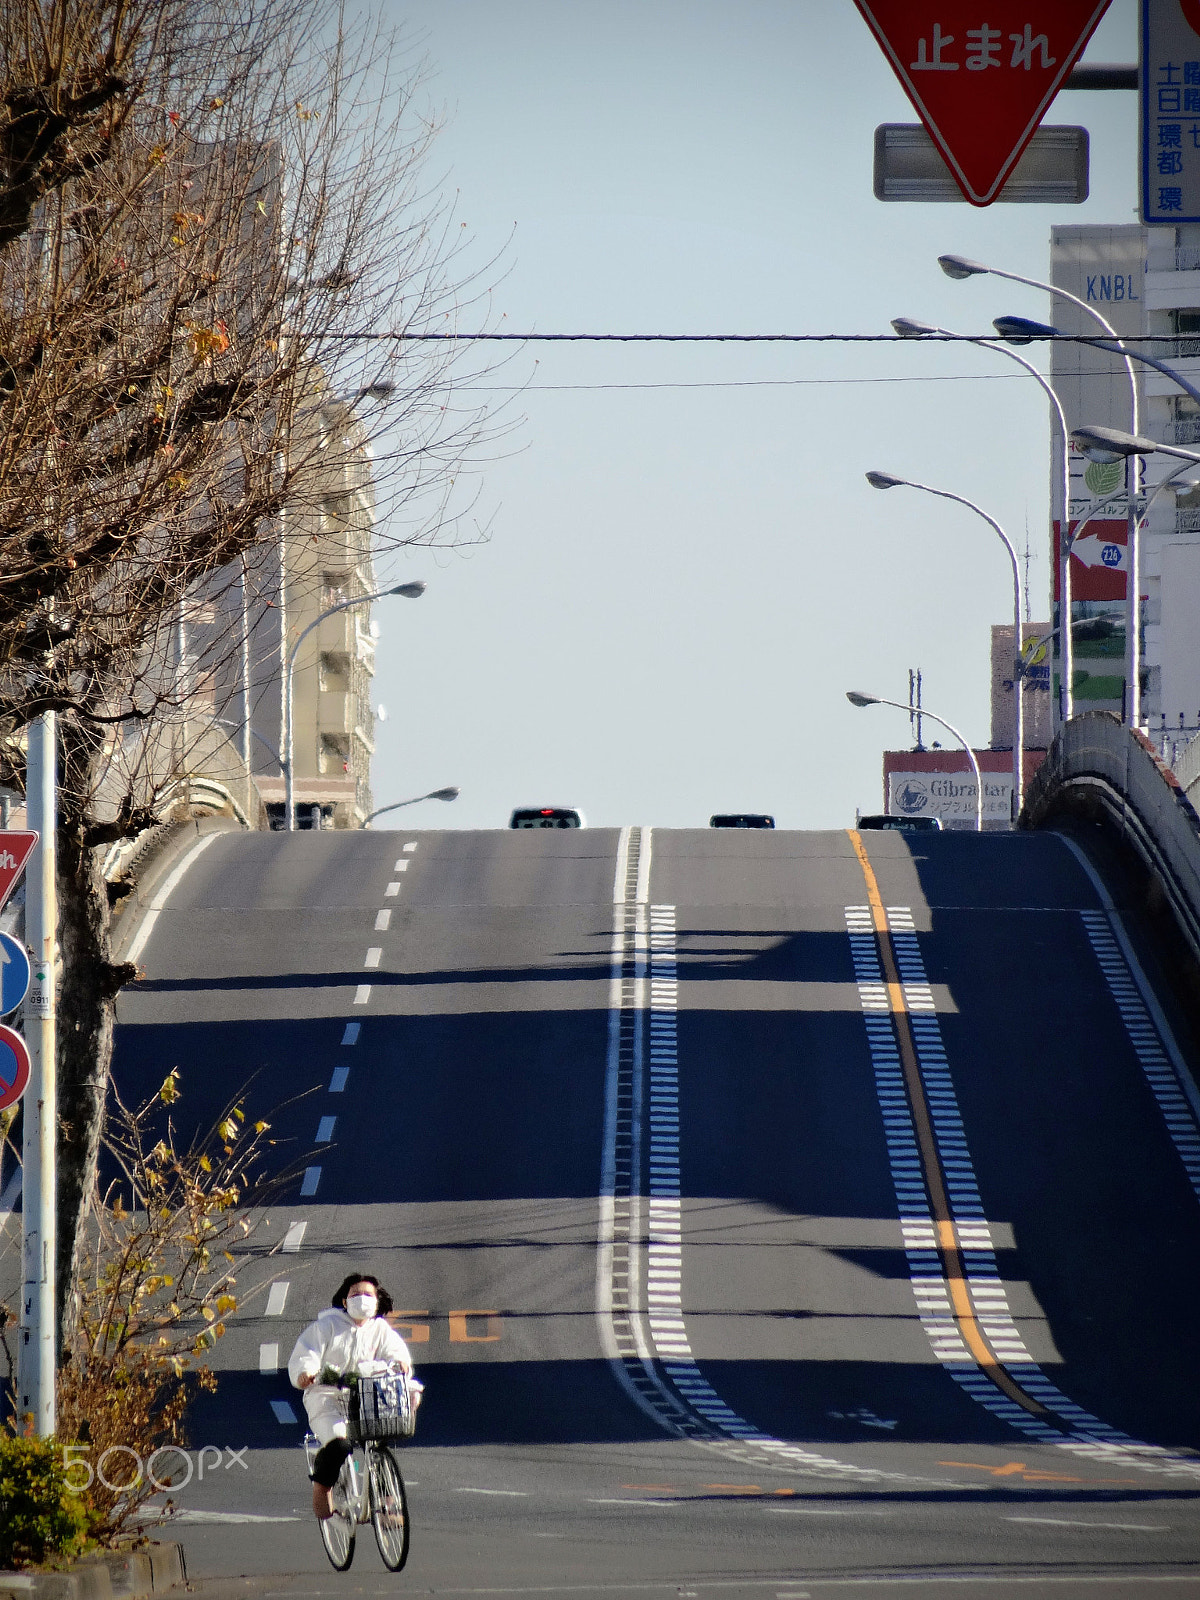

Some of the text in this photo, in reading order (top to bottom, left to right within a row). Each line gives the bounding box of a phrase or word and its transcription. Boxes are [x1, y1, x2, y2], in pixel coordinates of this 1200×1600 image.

[909, 22, 1057, 71] 止まれ
[1157, 151, 1183, 176] 都
[1157, 187, 1183, 212] 環
[1086, 274, 1139, 301] KNBL
[930, 779, 1009, 798] Gibratar
[0, 849, 17, 869] れ
